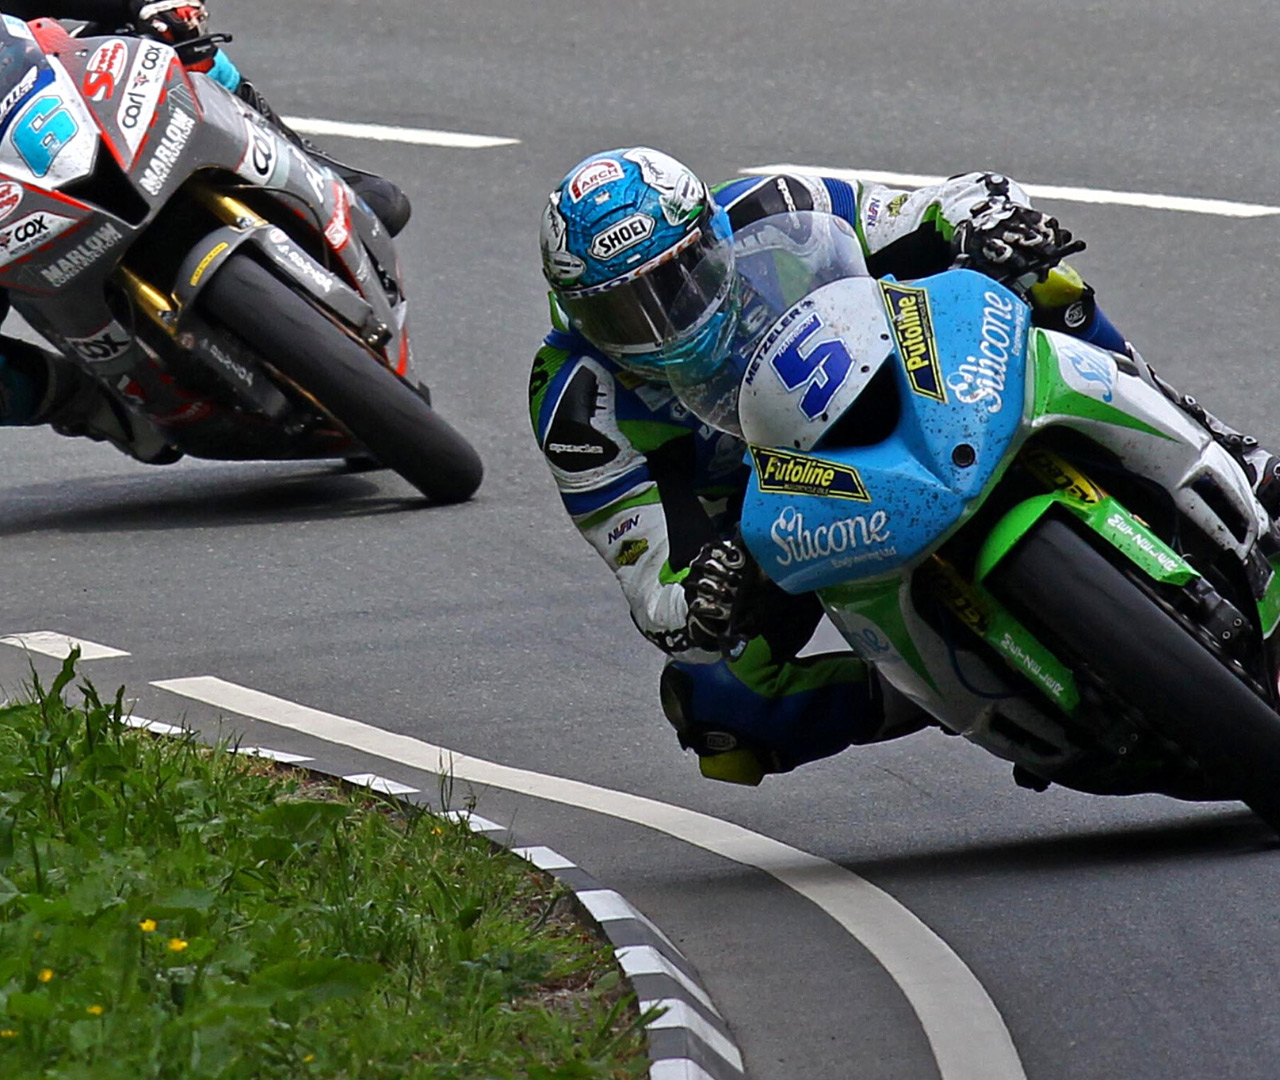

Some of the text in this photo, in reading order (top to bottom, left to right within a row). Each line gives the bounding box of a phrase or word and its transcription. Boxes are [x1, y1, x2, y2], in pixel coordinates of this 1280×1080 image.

[122, 44, 162, 129] carl cox
[11, 94, 80, 179] 6
[140, 107, 195, 192] MARLOW
[580, 167, 619, 190] ARCH
[14, 214, 49, 242] cox
[41, 222, 120, 282] MARLOW
[597, 218, 649, 254] SHOEI
[744, 307, 802, 387] METZELER
[769, 311, 855, 422] 5
[899, 292, 931, 370] Putoline
[945, 291, 1013, 413] Silicone
[762, 457, 835, 488] Putoline
[770, 506, 890, 567] Silicone
